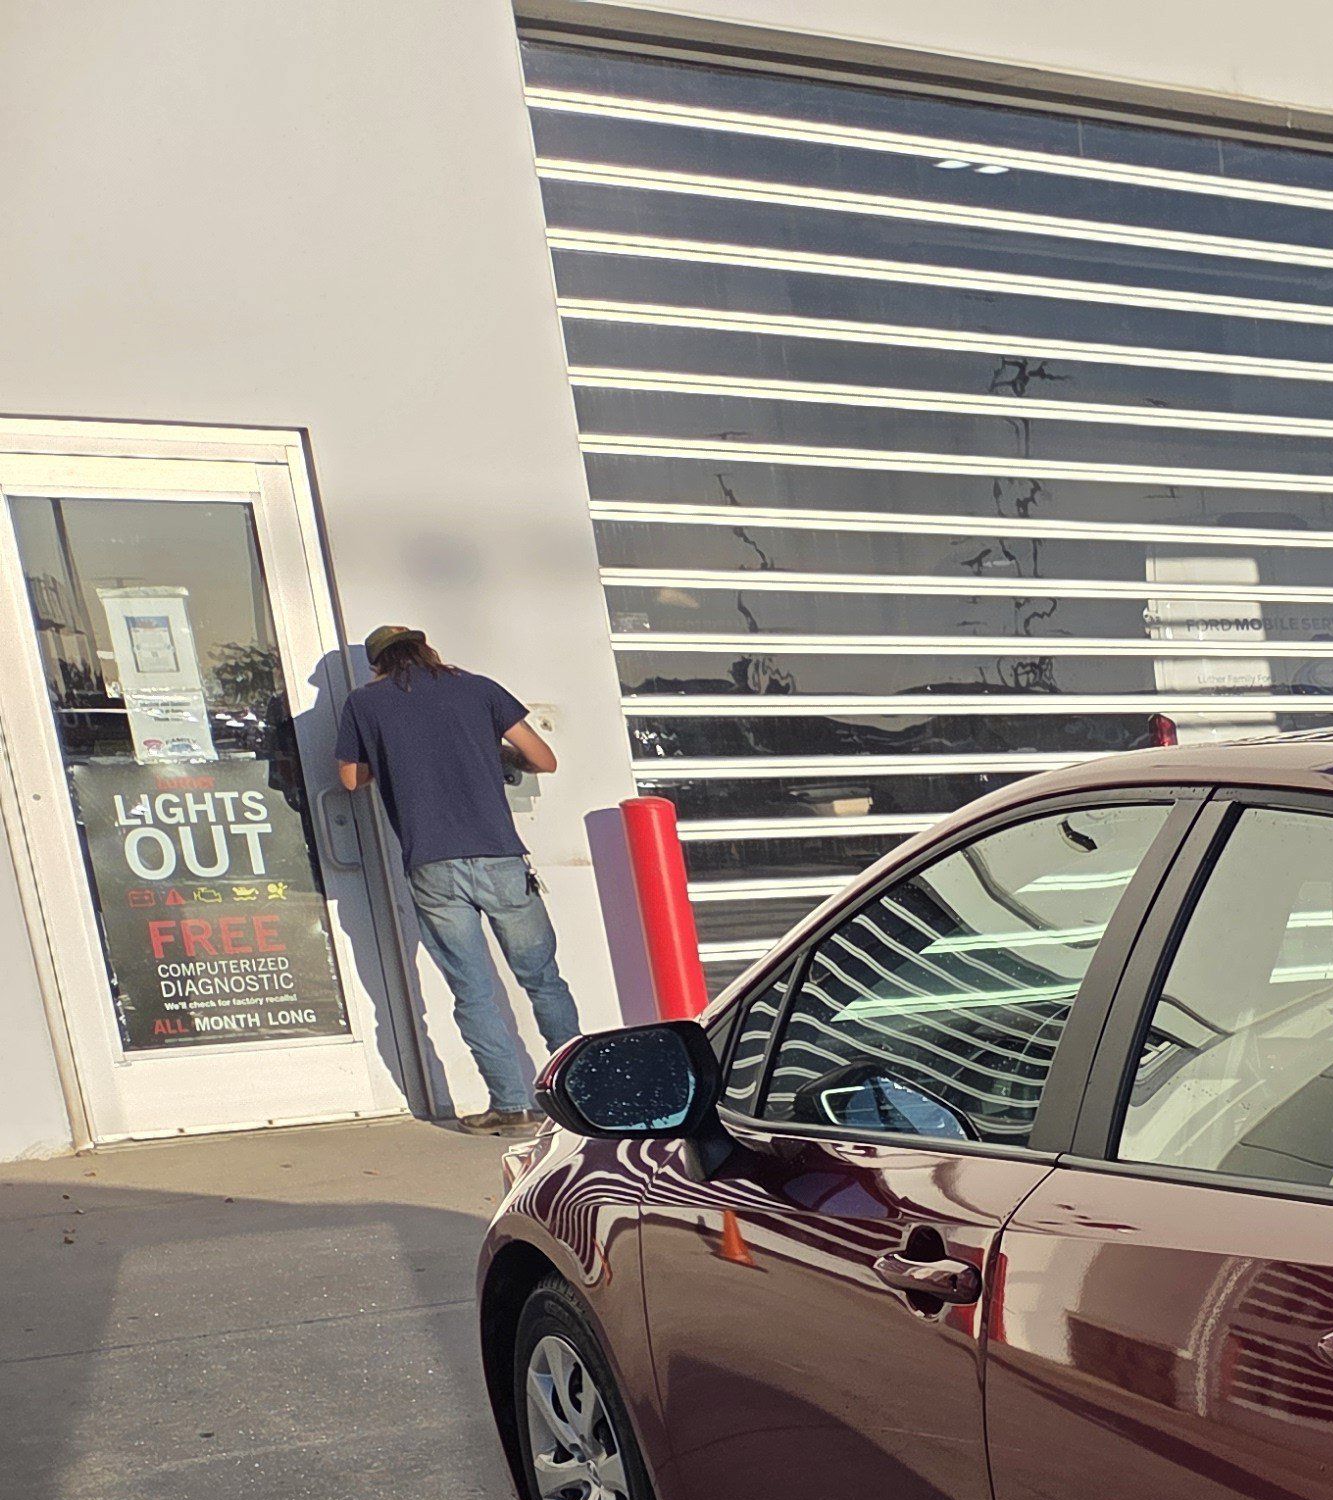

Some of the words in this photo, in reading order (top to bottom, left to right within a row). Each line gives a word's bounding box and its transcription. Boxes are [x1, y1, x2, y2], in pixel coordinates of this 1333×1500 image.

[1185, 618, 1232, 632] FORD
[1235, 617, 1299, 632] MOBILE
[113, 790, 268, 826] LIGHTS
[124, 823, 273, 881] OUT
[149, 914, 287, 959] FREE
[157, 956, 289, 979] COMPUTERIZED
[160, 972, 294, 998] DIAGNOSTIC
[217, 998, 231, 1008] for
[154, 1018, 190, 1035] ALL
[194, 1012, 261, 1032] MONTH
[267, 1009, 317, 1026] LONG
